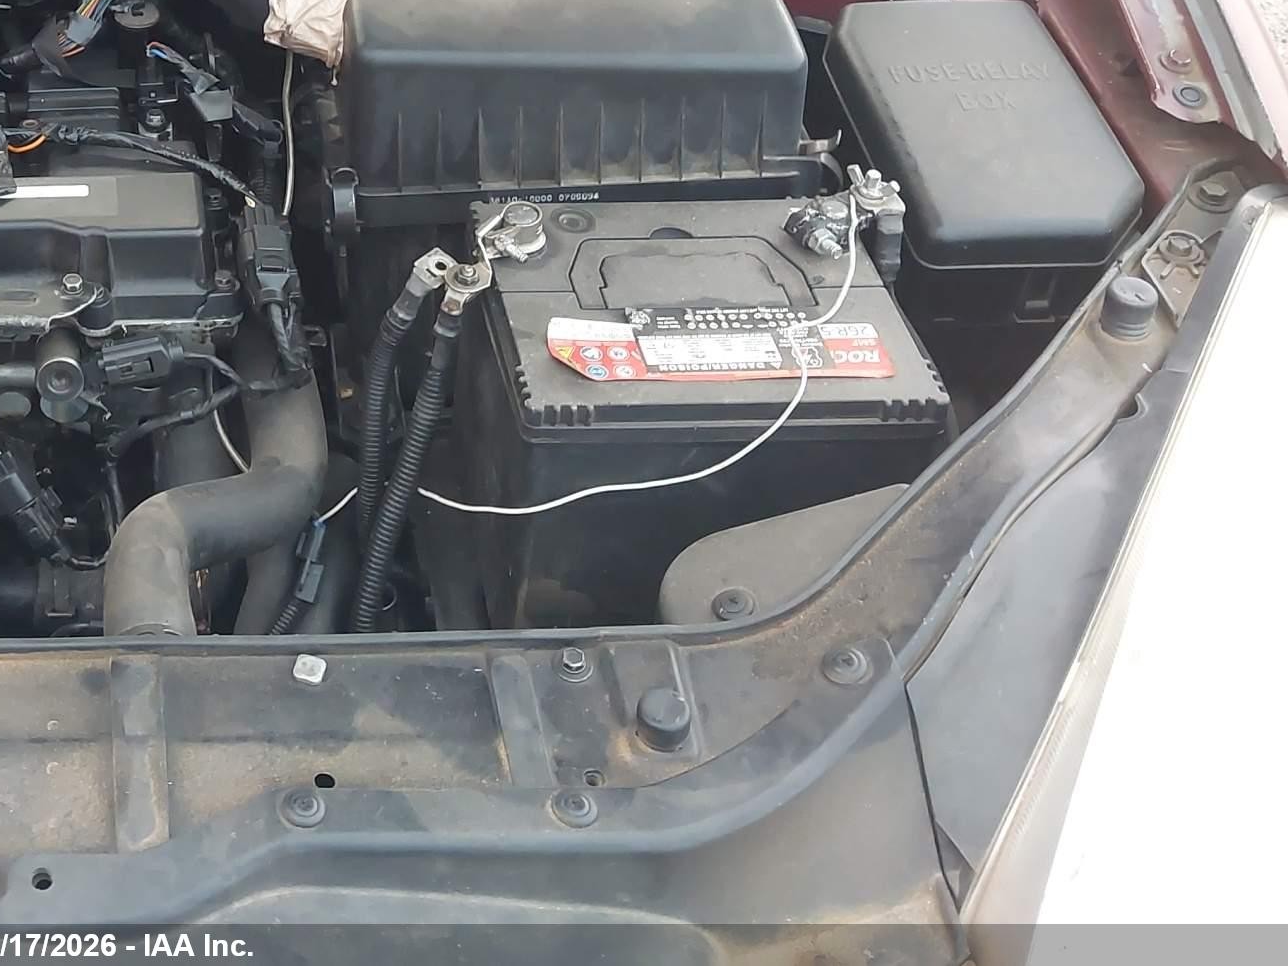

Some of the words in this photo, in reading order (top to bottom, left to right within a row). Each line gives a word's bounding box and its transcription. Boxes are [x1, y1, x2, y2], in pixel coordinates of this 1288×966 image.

[888, 62, 1049, 83] FUSE-RELAY
[954, 90, 1016, 112] BOX
[830, 349, 880, 363] ROC
[659, 362, 765, 371] DANGER/POISON
